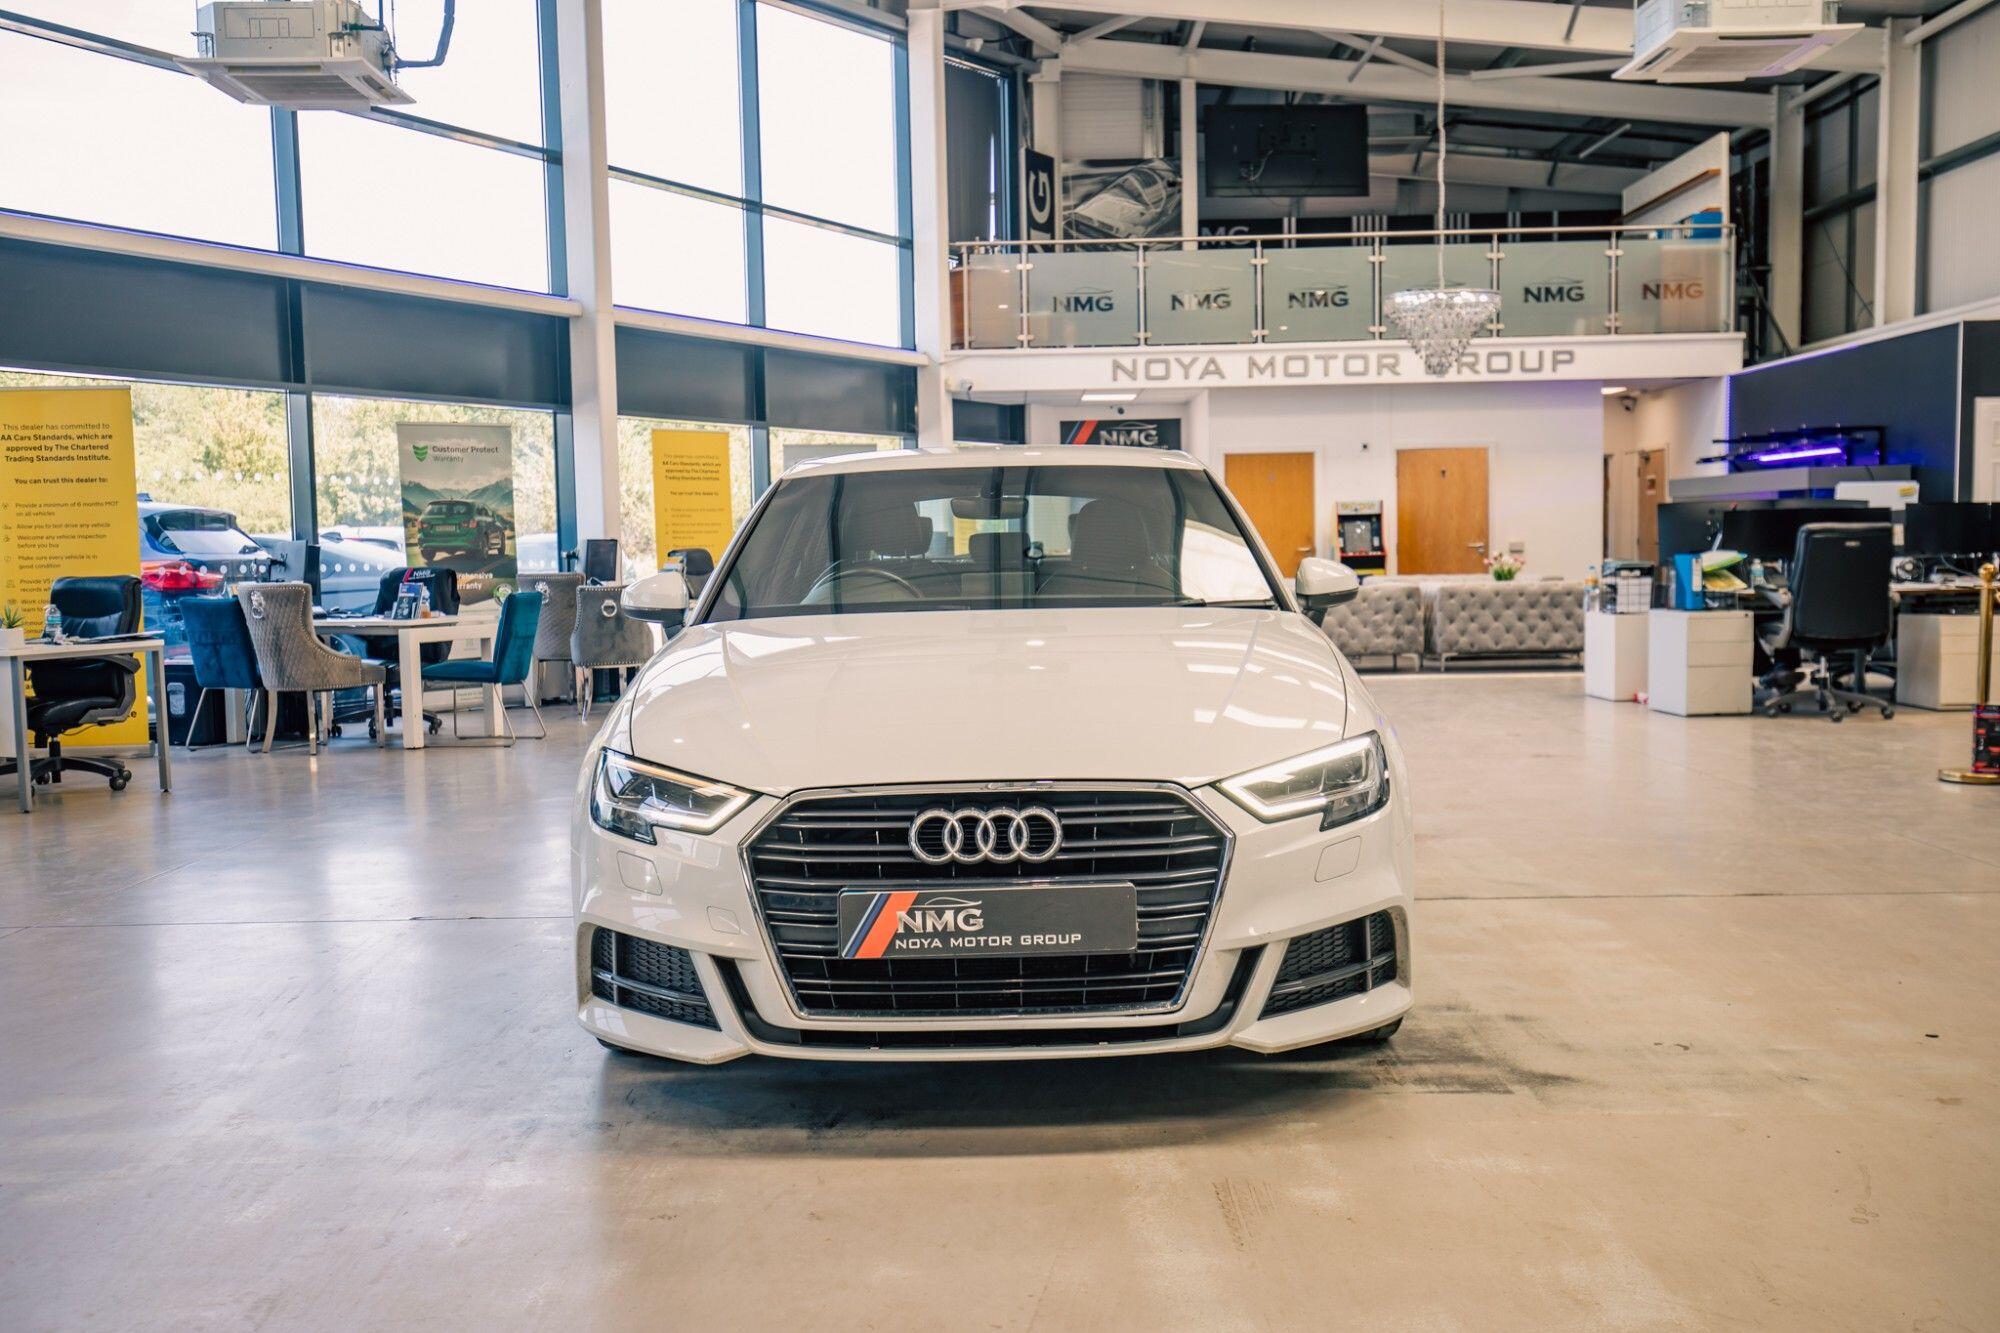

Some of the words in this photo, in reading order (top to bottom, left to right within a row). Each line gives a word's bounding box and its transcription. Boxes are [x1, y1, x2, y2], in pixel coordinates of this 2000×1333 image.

[1288, 291, 1349, 308] NMG
[1523, 285, 1586, 303] NMG
[1642, 282, 1704, 300] NMG
[1053, 295, 1114, 312] NMG
[1171, 293, 1232, 310] NMG
[1111, 357, 1226, 381] NOYA
[1248, 352, 1401, 379] MOTOR
[1426, 349, 1575, 376] ROUP
[33, 433, 75, 441] Standards,
[1100, 429, 1159, 446] NMG
[6, 444, 42, 452] approved
[44, 444, 53, 452] by
[432, 445, 469, 453] Customer
[5, 455, 34, 463] Trading
[15, 477, 28, 485] You
[896, 908, 984, 934] NMG
[895, 938, 942, 949] NOYA
[950, 936, 1013, 946] MOTOR
[1020, 932, 1082, 944] GROUP
